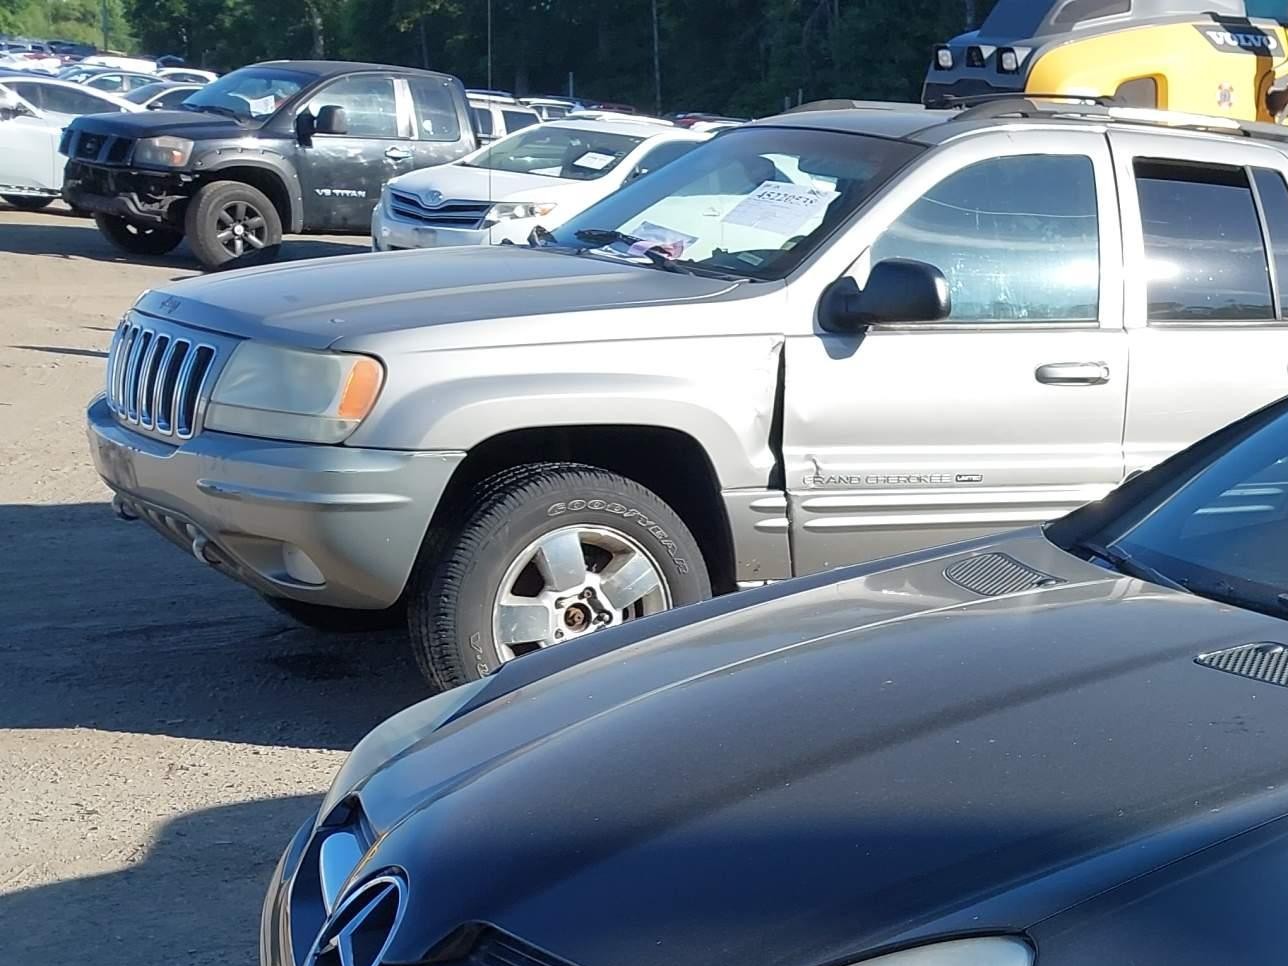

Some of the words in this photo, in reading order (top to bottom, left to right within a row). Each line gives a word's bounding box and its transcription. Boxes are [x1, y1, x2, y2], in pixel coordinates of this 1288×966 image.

[1205, 30, 1278, 50] VOLVO
[314, 188, 331, 197] V8
[332, 188, 366, 199] TITAN
[802, 474, 861, 485] GRAND
[865, 473, 952, 484] CHEROKEE
[547, 499, 689, 575] GOODYEAR
